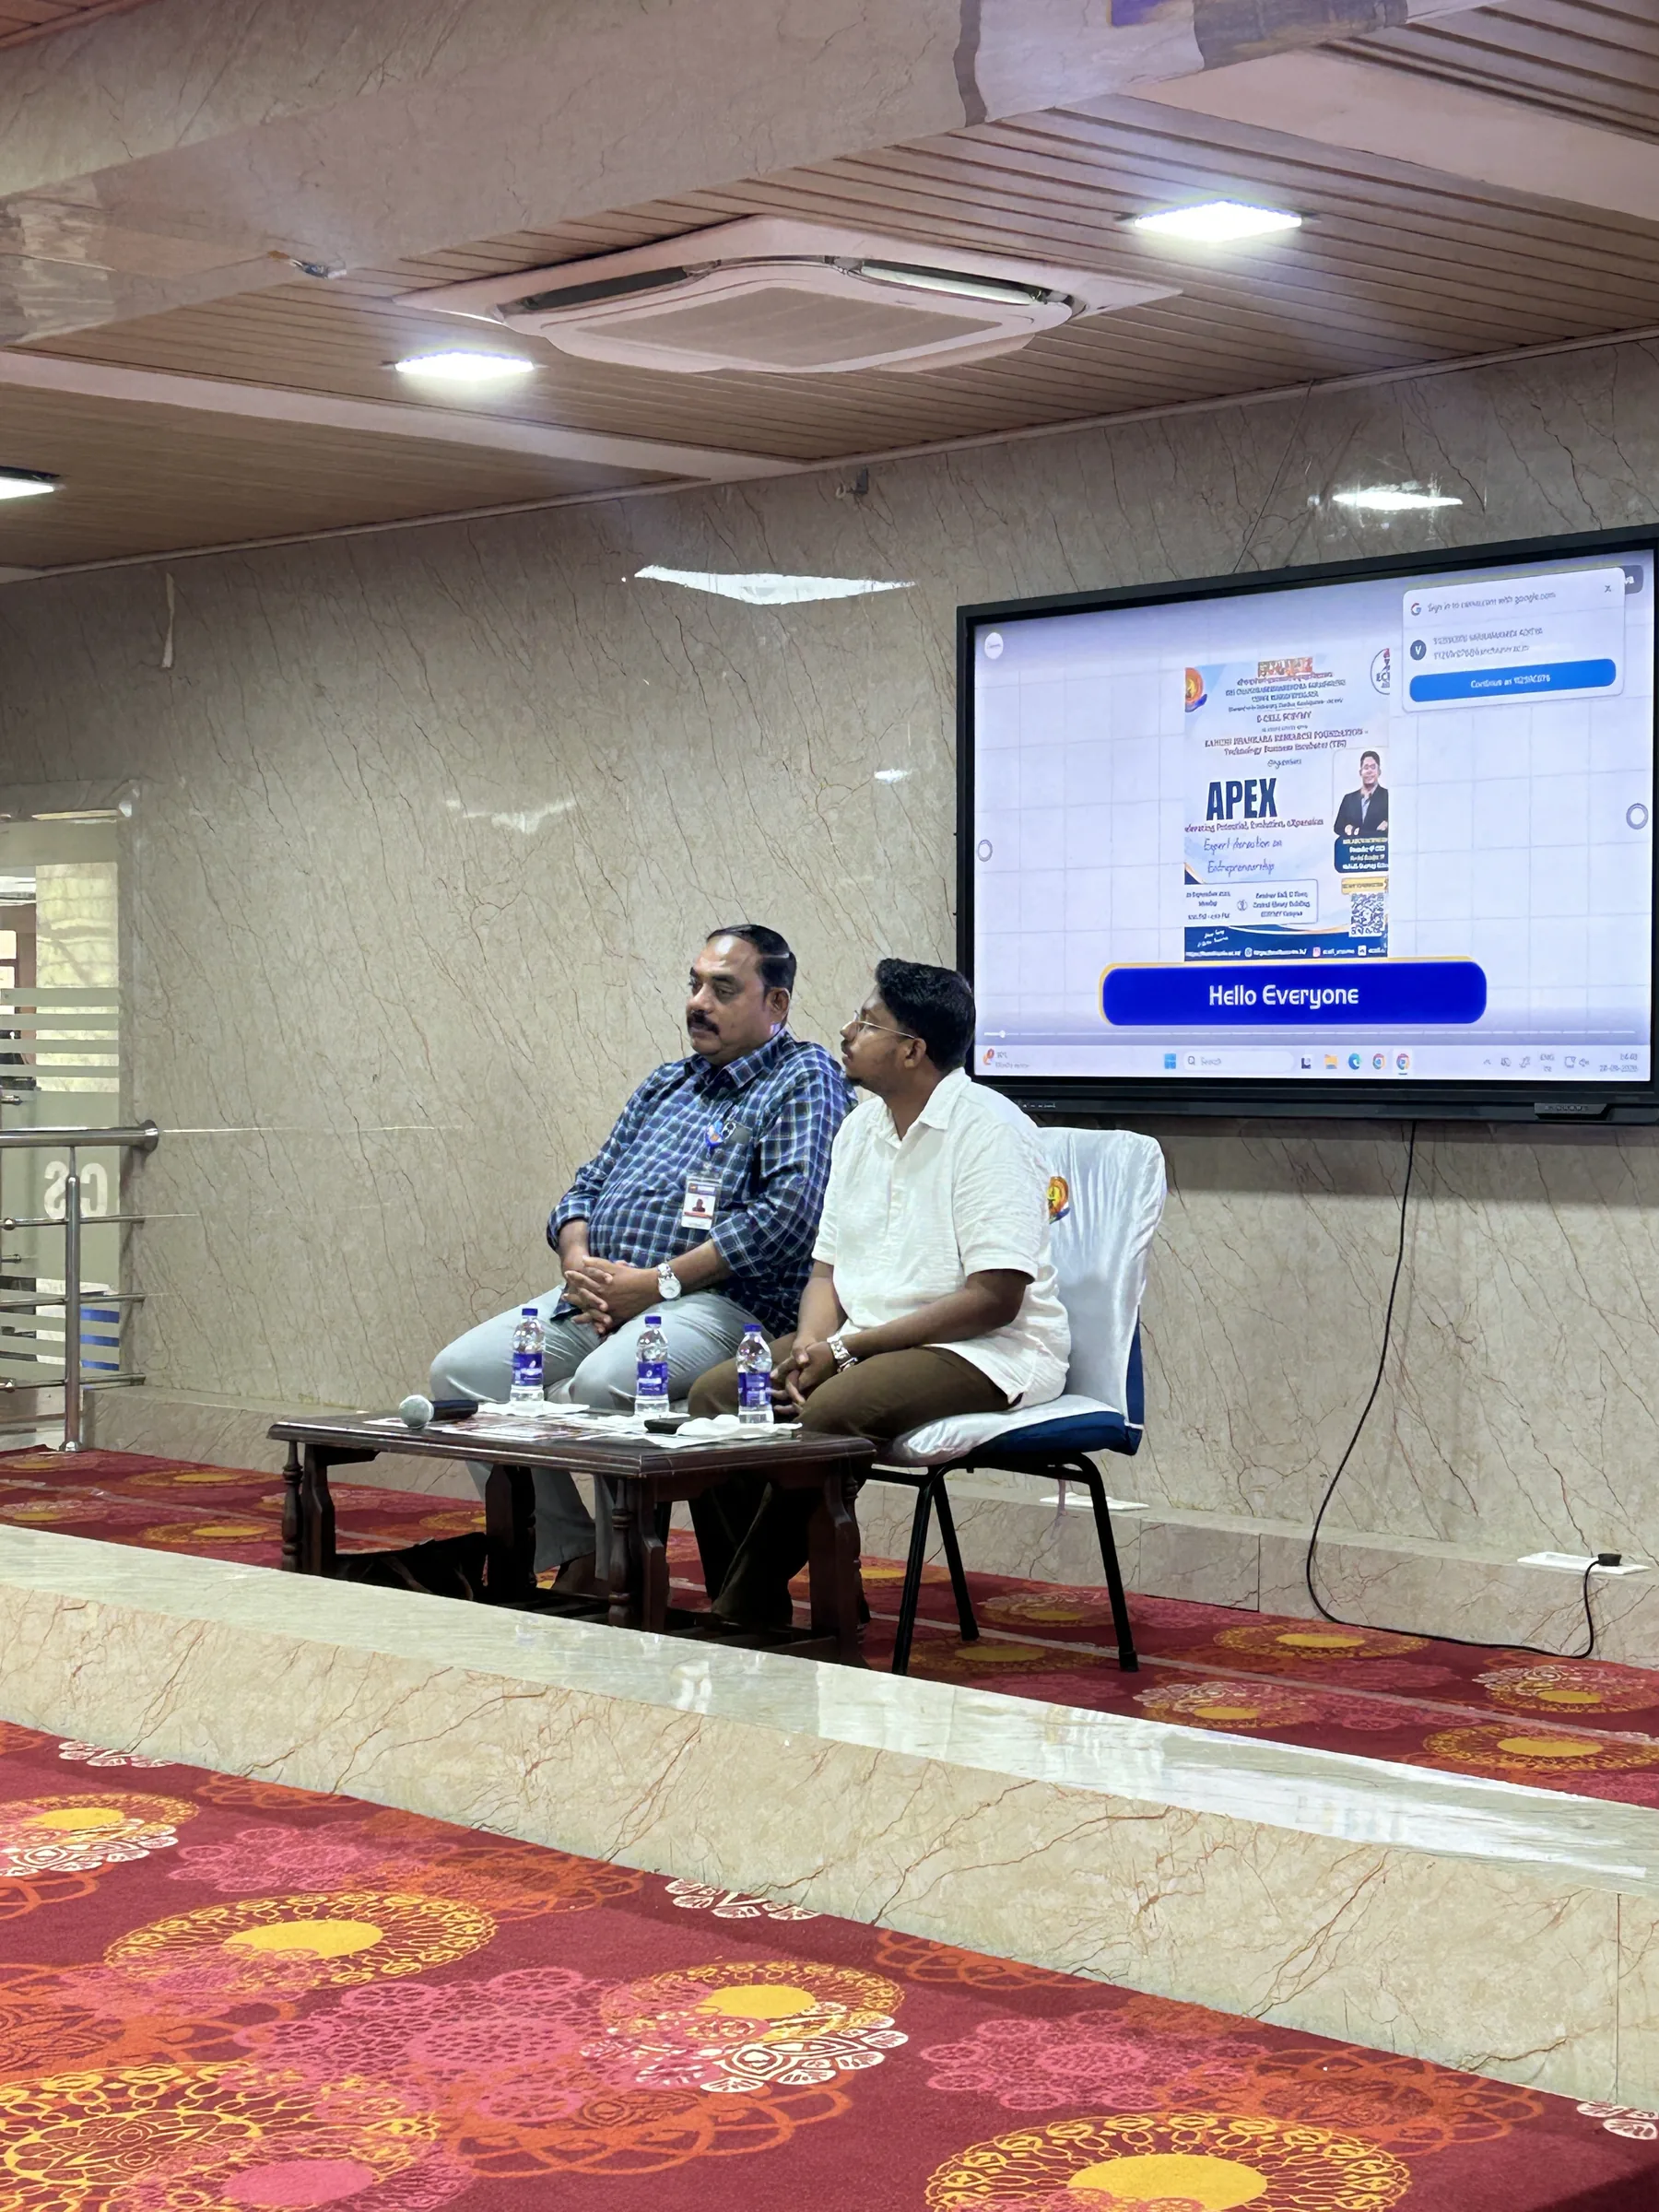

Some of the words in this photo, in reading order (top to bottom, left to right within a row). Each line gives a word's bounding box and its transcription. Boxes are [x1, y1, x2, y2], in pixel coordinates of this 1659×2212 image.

[1206, 777, 1278, 821] APEX
[1209, 984, 1257, 1006] Hello
[1262, 984, 1359, 1010] Everyone
